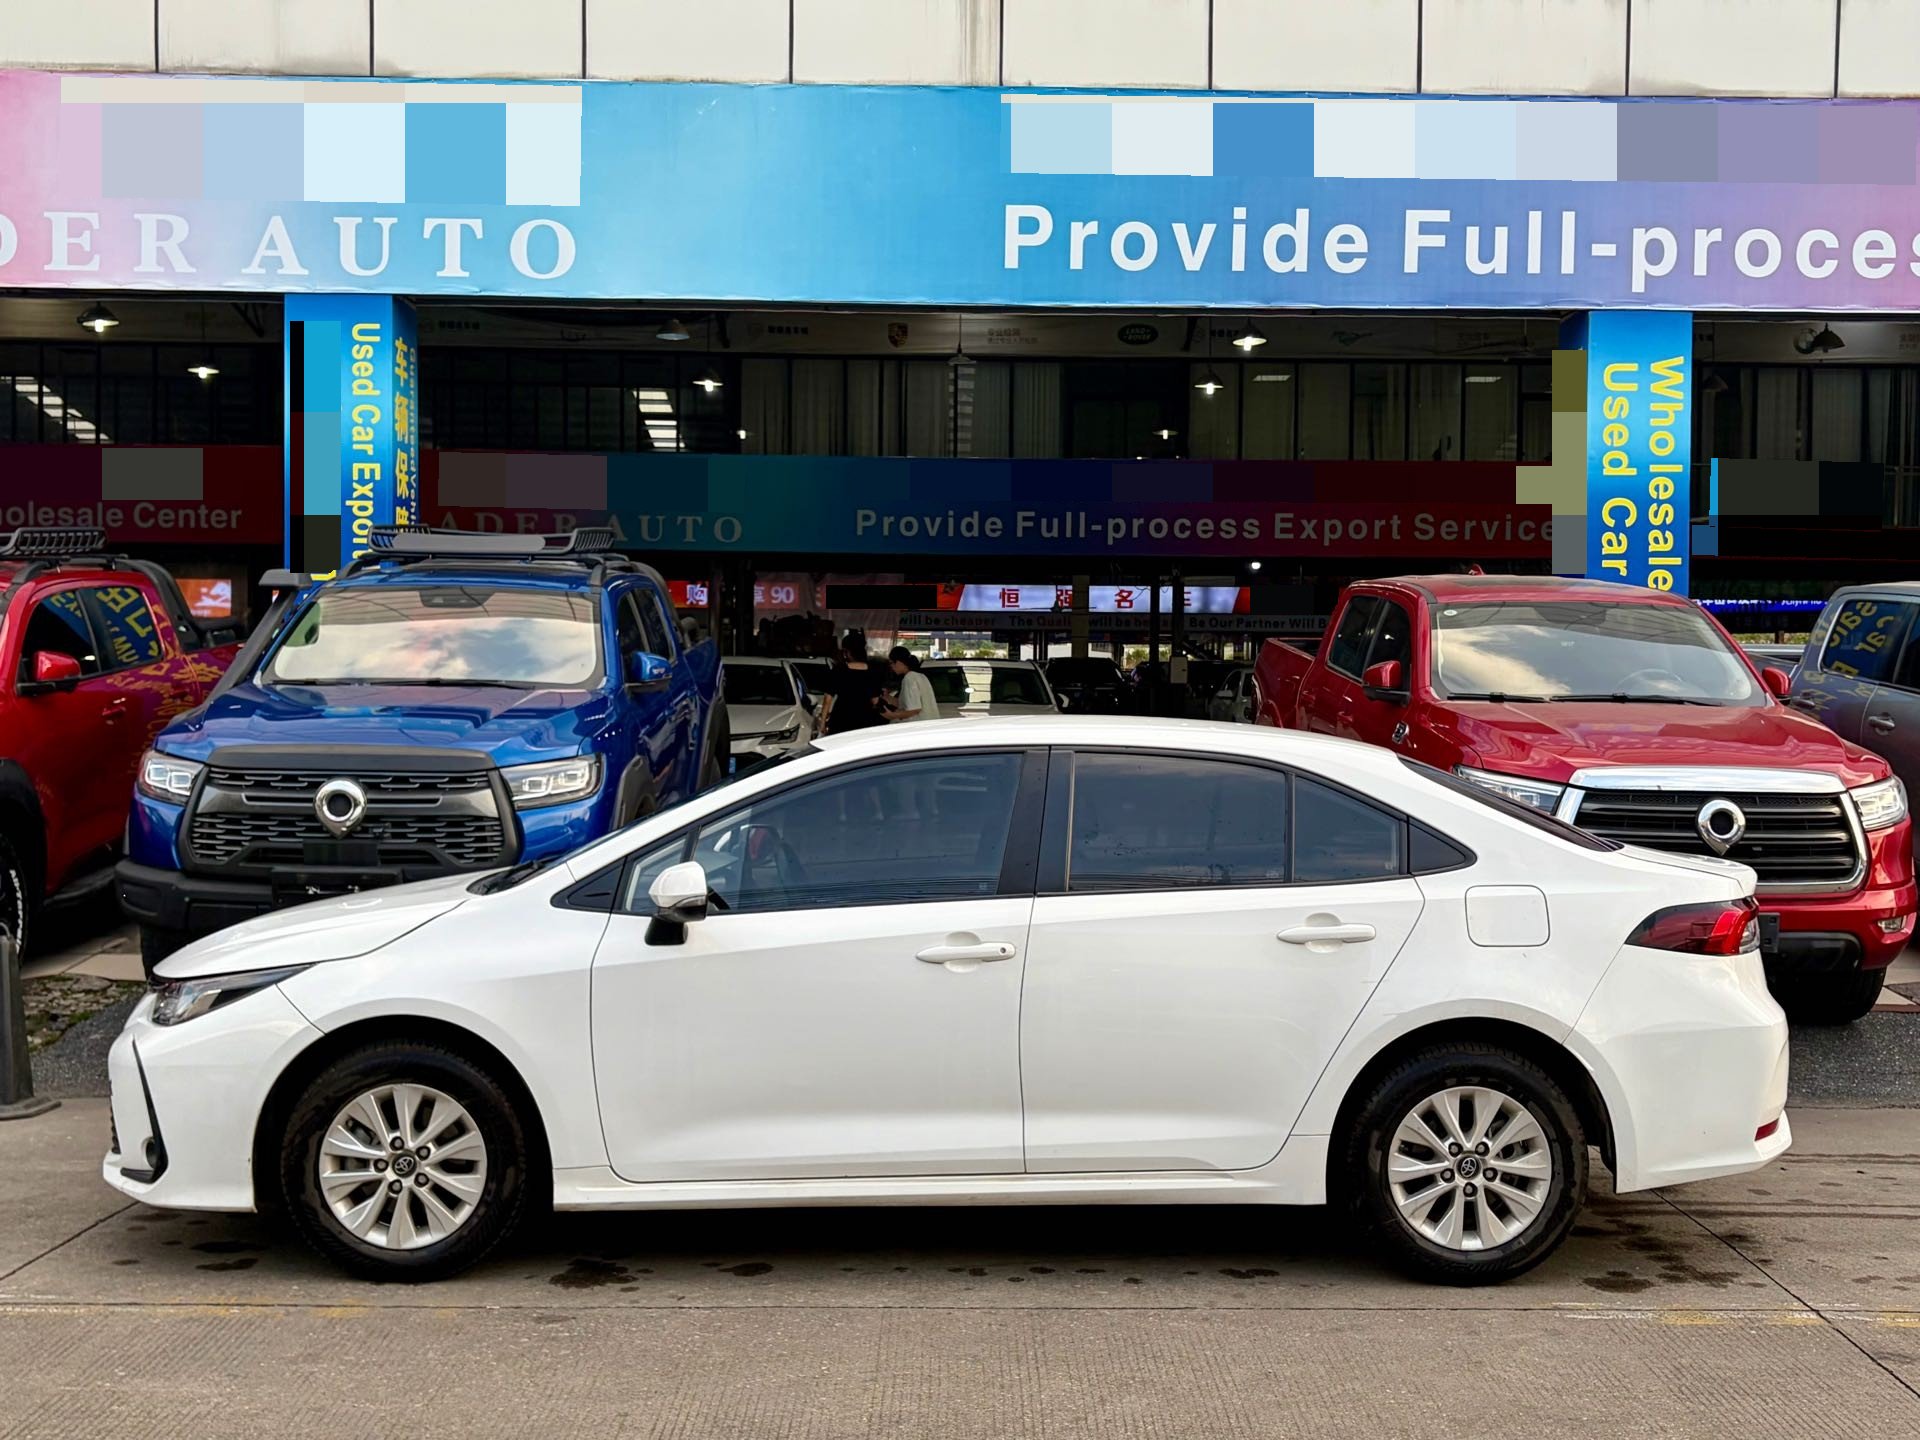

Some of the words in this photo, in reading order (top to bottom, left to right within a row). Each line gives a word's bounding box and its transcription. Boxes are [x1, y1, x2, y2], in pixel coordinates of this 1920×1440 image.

[0, 210, 196, 274] ER
[241, 214, 578, 280] AUTO
[1003, 204, 1369, 273] Provide
[1402, 208, 1920, 293] Full-proce
[351, 322, 382, 396] Used
[351, 403, 382, 456] Car
[1602, 362, 1640, 477] Used
[1647, 356, 1685, 592] Wholesale
[0, 501, 123, 528] olesale
[133, 502, 242, 529] Center
[605, 512, 744, 543] AUTO
[856, 509, 1003, 538] Provide
[1015, 511, 1260, 545] Full-process
[1274, 513, 1401, 546] Export
[1601, 496, 1638, 577] Car
[770, 586, 795, 604] 90
[925, 614, 941, 626] be
[943, 614, 995, 628] cheaper
[1009, 615, 1032, 626] The
[1088, 615, 1112, 627] will
[1209, 617, 1233, 629] Our
[1236, 617, 1286, 629] Partner
[1288, 618, 1315, 629] Will
